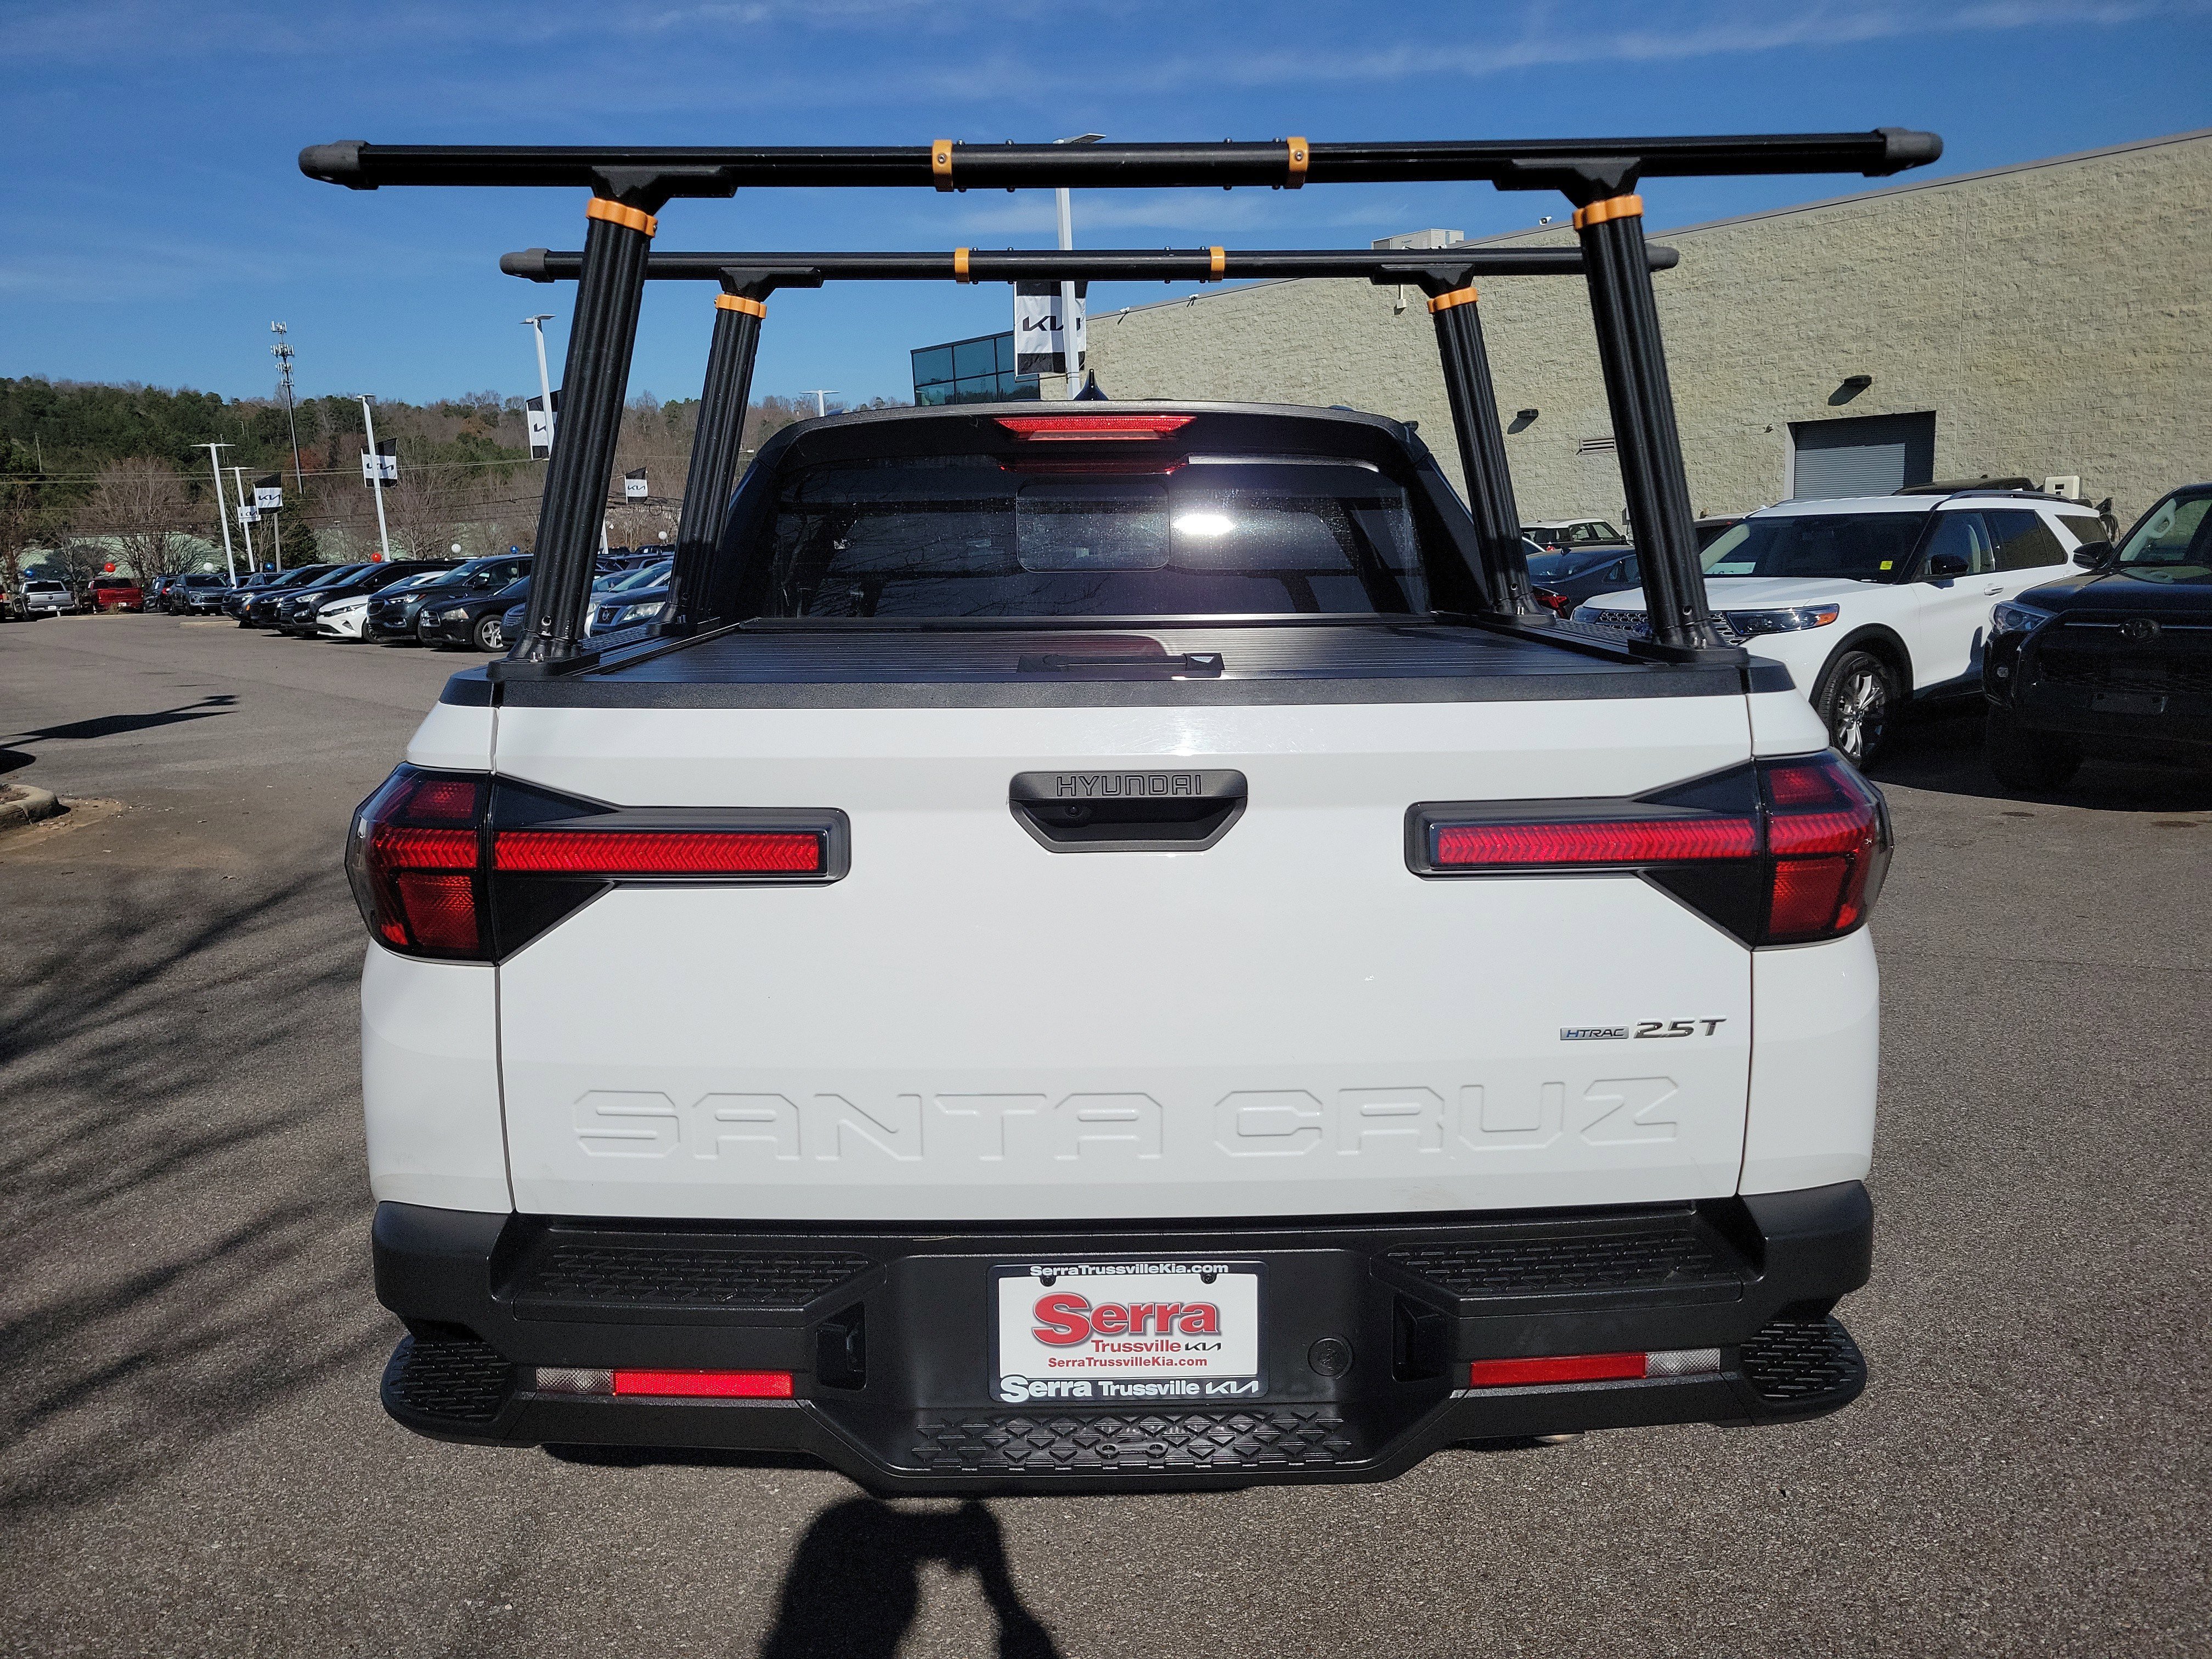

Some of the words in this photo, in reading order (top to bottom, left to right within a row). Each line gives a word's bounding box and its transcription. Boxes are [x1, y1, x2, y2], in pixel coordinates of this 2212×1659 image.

[1056, 774, 1203, 797] HYUNDAI
[1566, 1029, 1625, 1038] HTRAC
[574, 1090, 1163, 1162] SANTA
[1215, 1076, 1679, 1156] CRUZ
[1030, 1263, 1228, 1276] SerraTrussvilleKia.com
[1032, 1293, 1218, 1345] Serra
[1091, 1339, 1181, 1352] Trussville
[1185, 1342, 1221, 1351] KIA
[1048, 1357, 1207, 1368] SerraTrussvilleKia.com
[1000, 1375, 1093, 1403] Serra
[1098, 1380, 1200, 1396] Trussville
[1206, 1380, 1259, 1395] KIA
